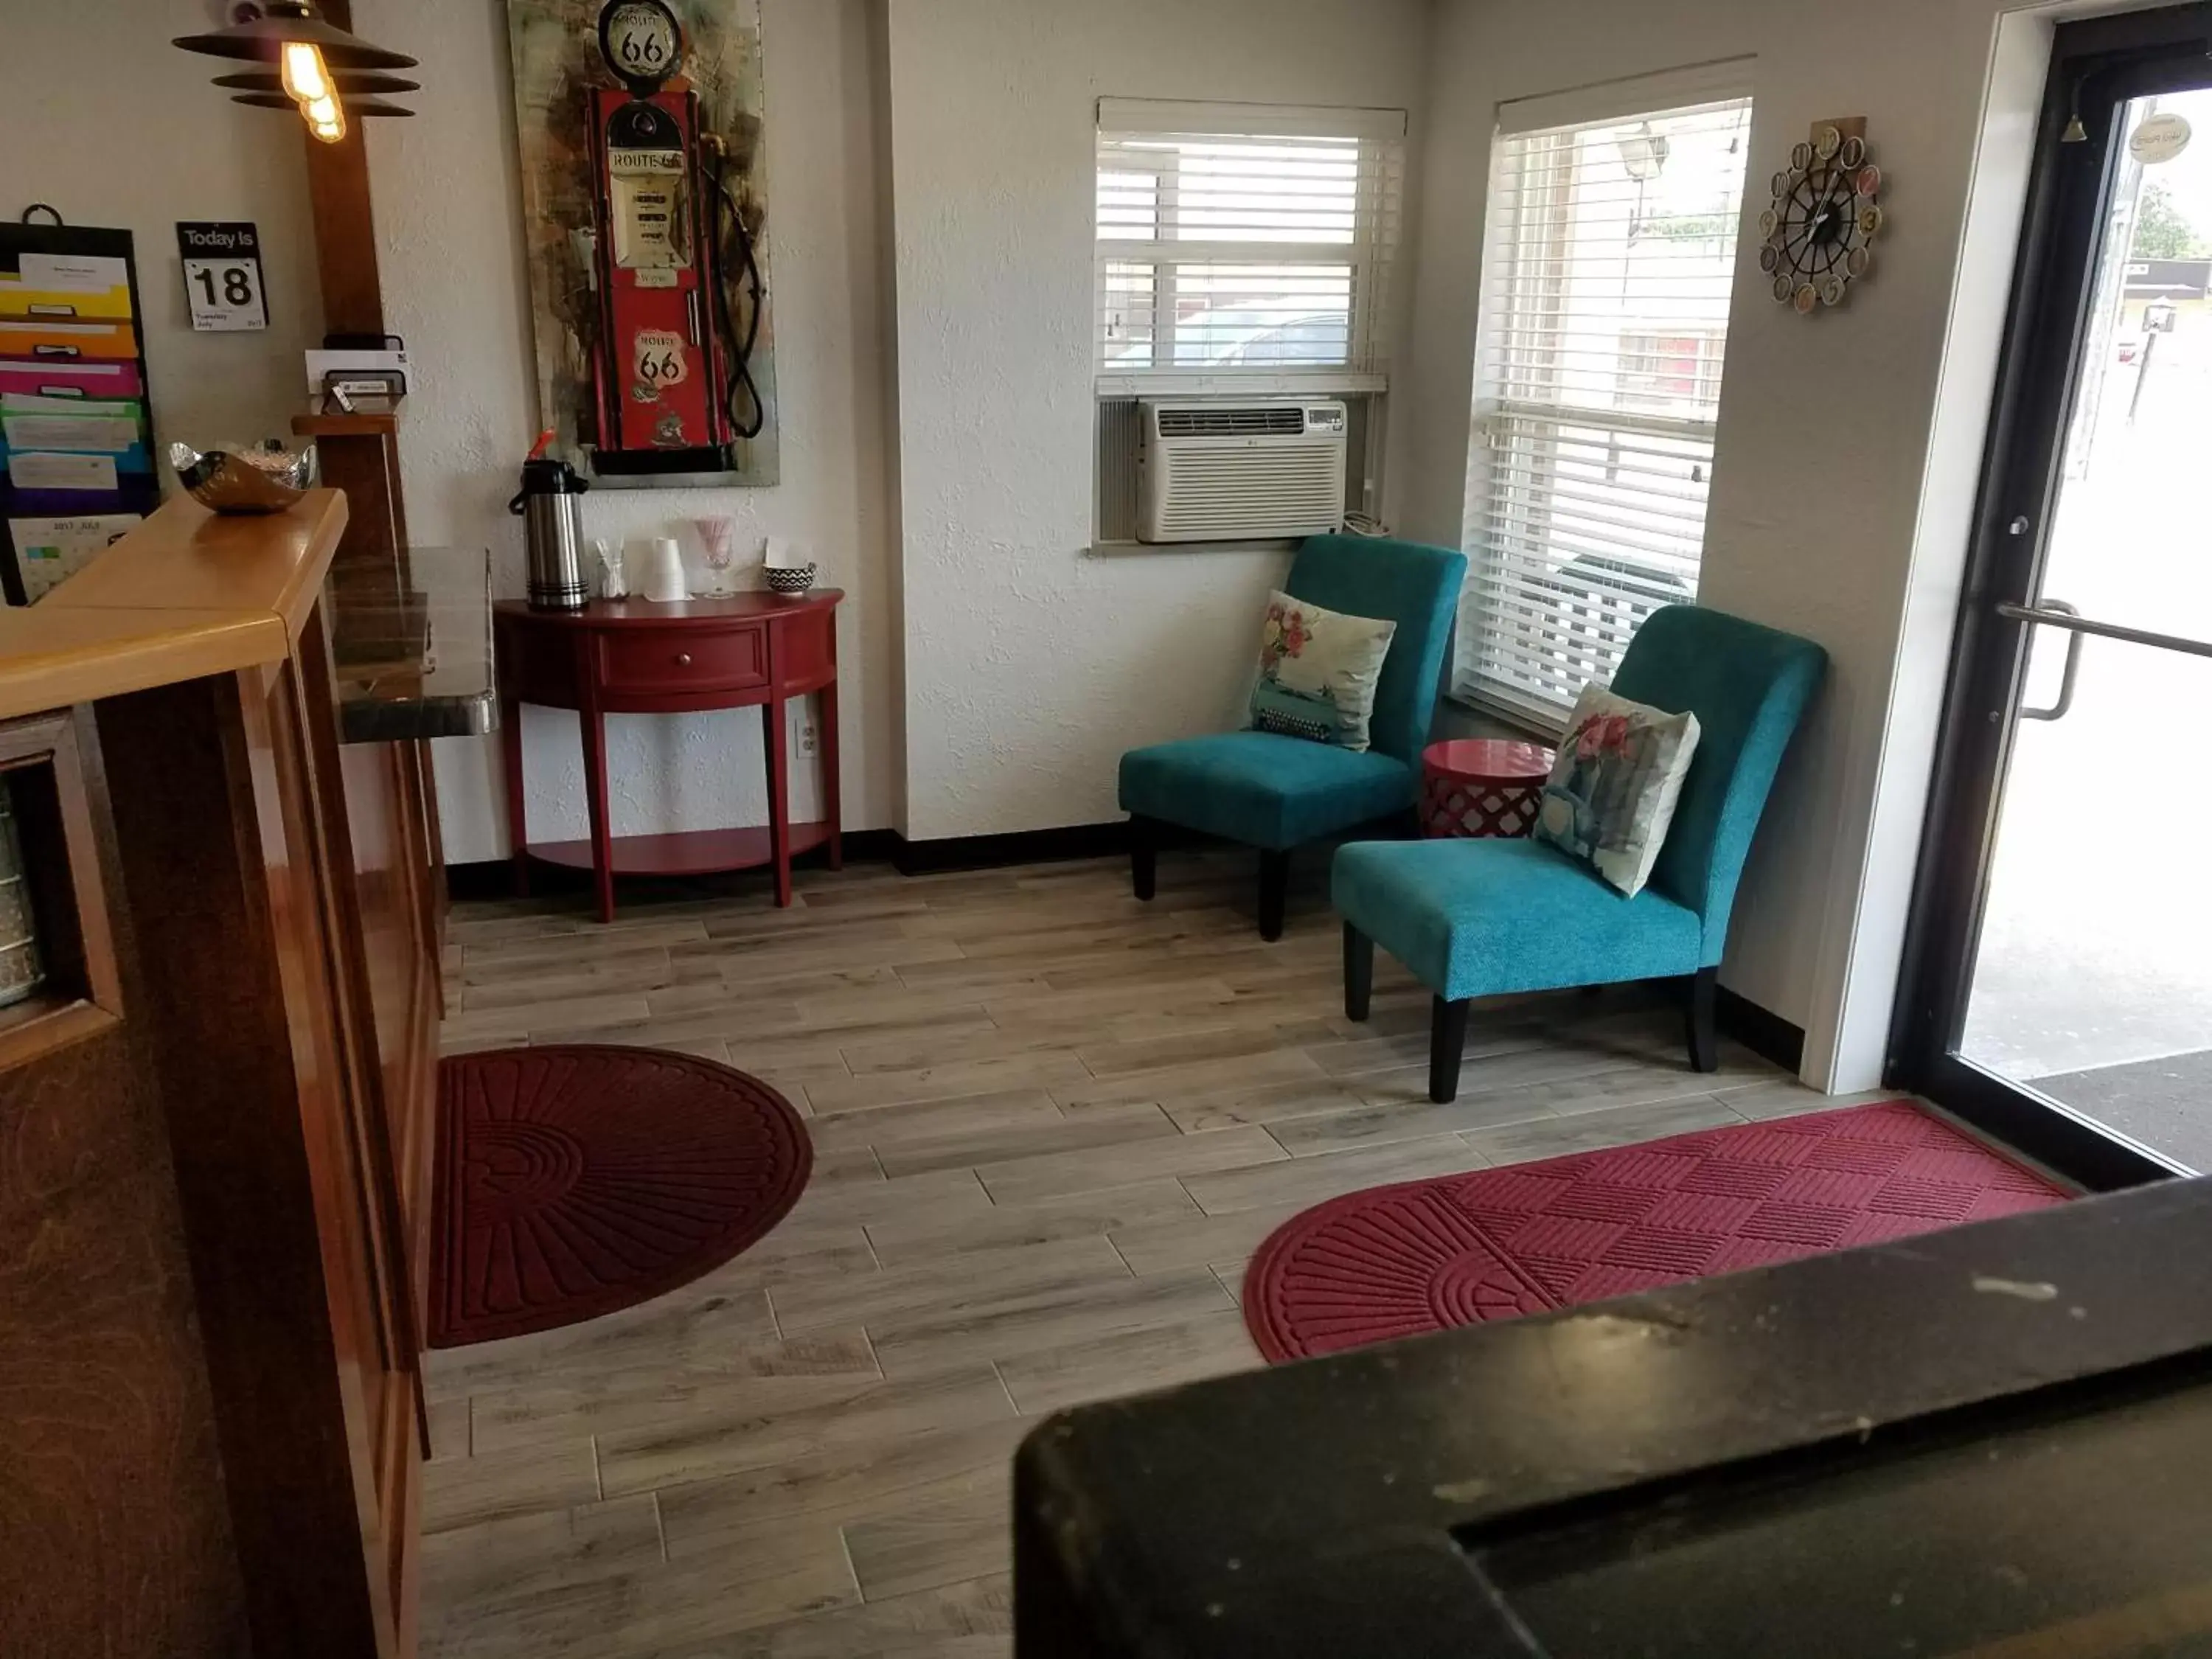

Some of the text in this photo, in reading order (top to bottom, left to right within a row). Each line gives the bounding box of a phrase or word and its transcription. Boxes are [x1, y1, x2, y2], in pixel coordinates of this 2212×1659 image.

[622, 31, 662, 62] 66
[613, 153, 655, 168] ROUTE
[184, 230, 254, 248] Today Is
[194, 268, 251, 306] 18
[640, 351, 679, 379] 66
